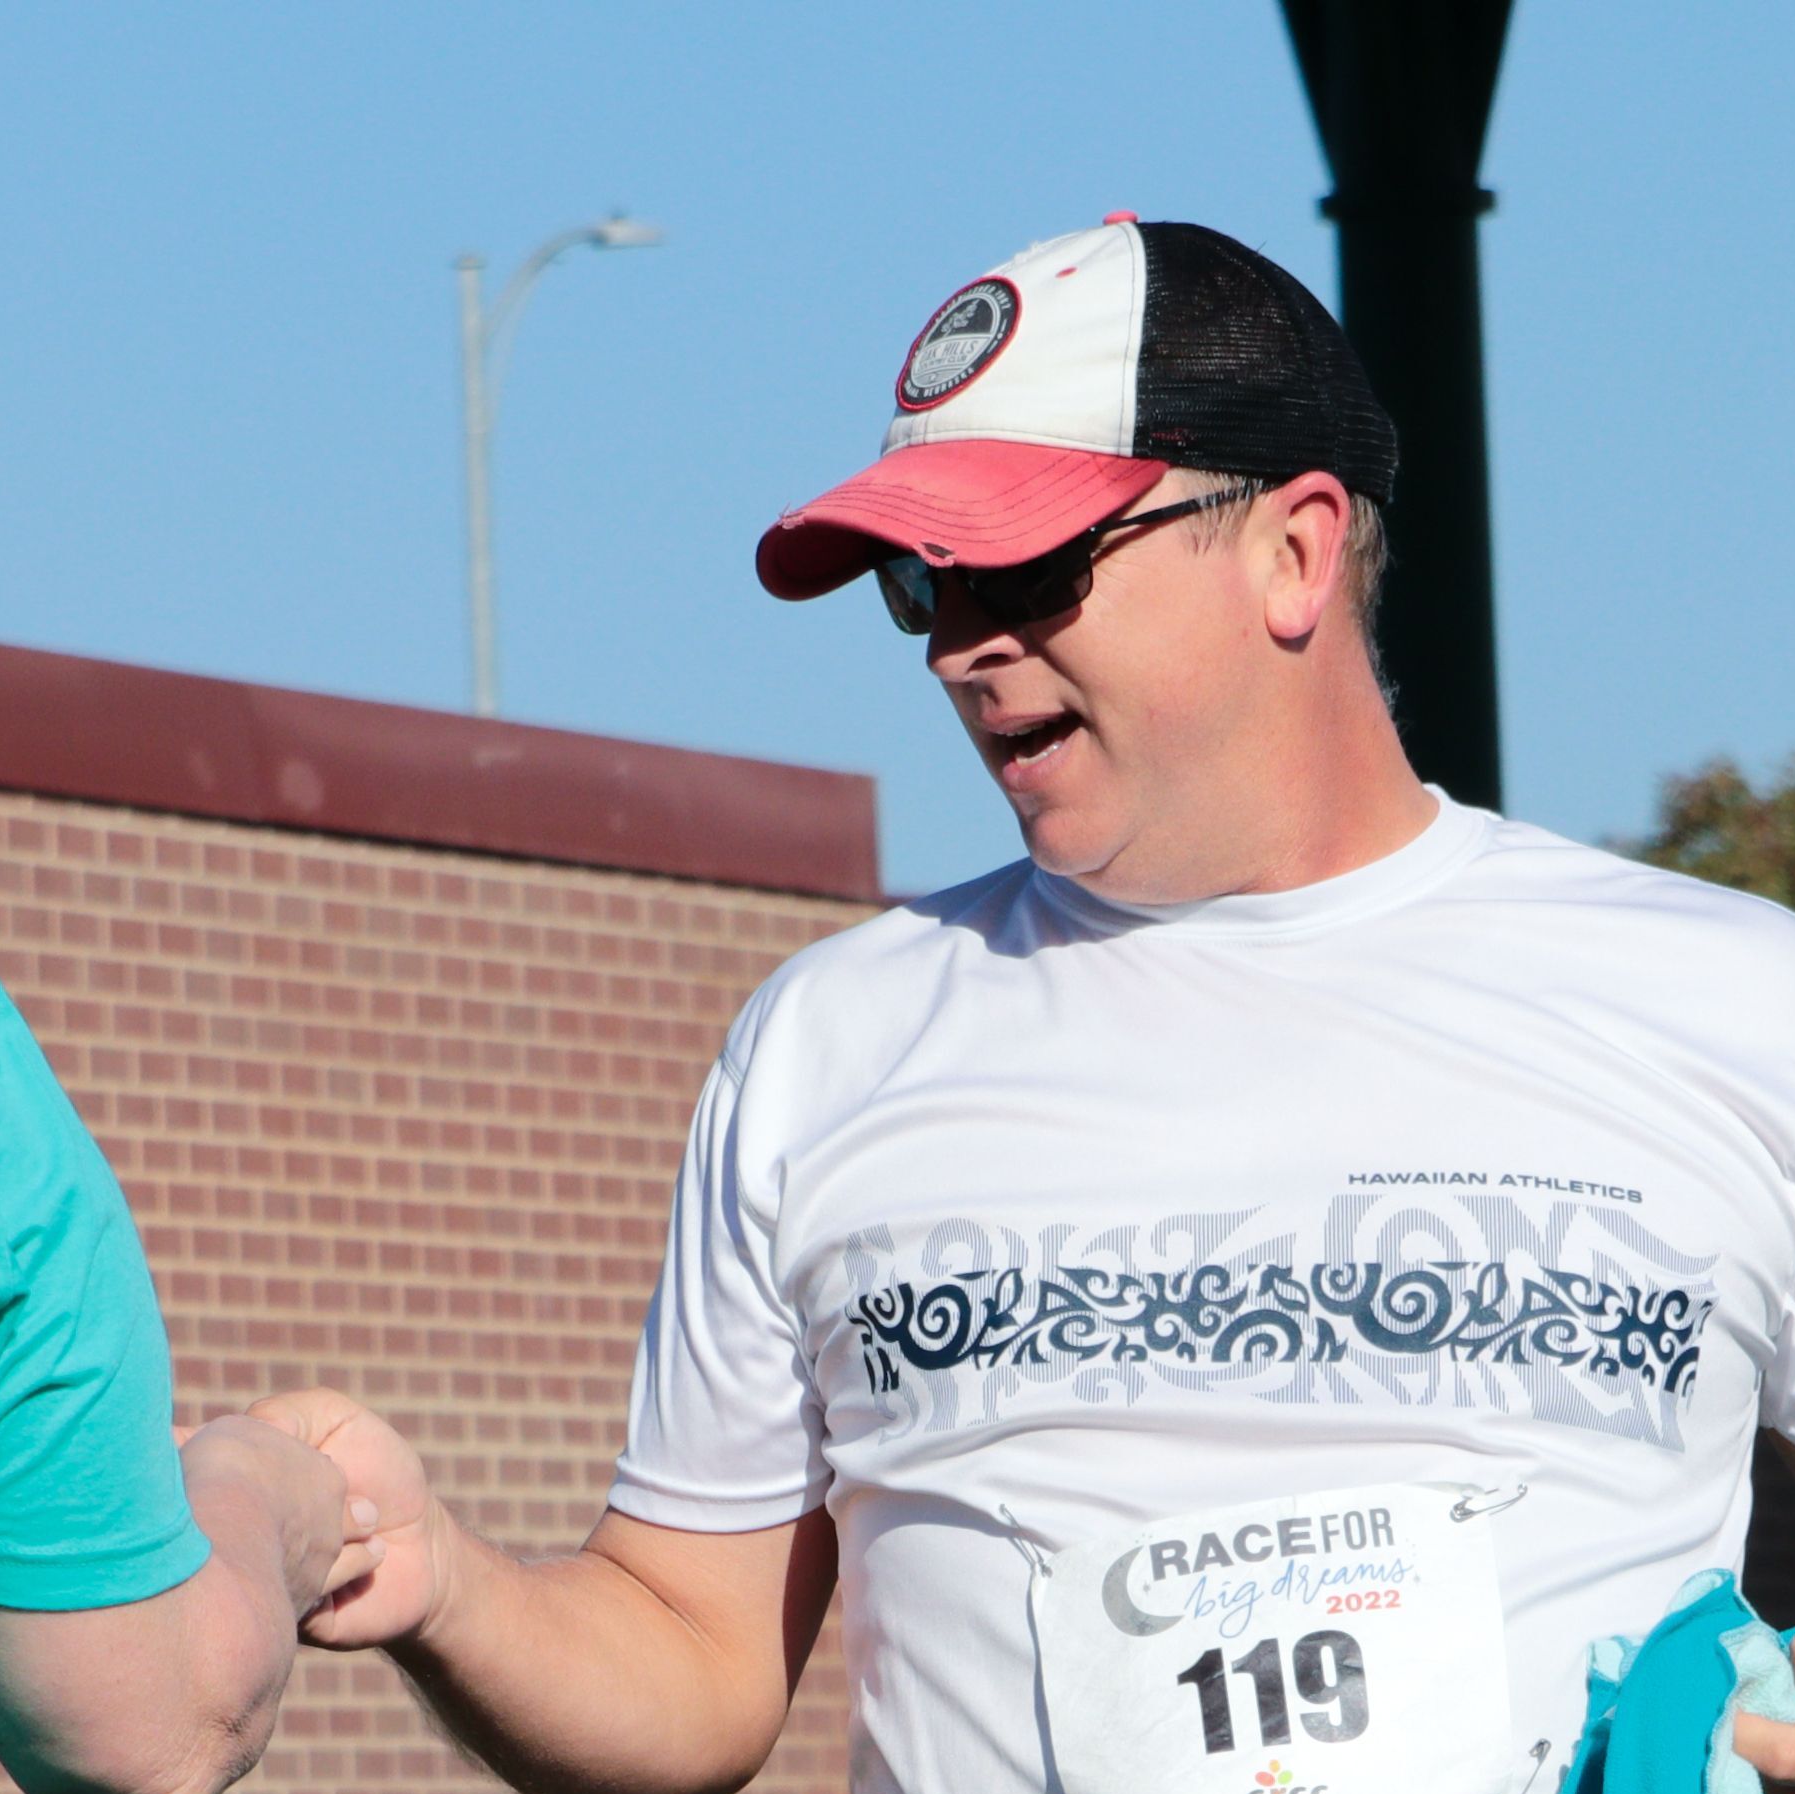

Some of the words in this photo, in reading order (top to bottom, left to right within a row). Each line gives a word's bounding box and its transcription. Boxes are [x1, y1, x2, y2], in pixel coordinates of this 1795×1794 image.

[1348, 1172, 1488, 1185] HAWAIIAN
[1498, 1173, 1644, 1204] ATHLETICS
[1149, 1517, 1317, 1581] RACE
[1321, 1507, 1396, 1554] FOR
[1184, 1574, 1265, 1640] big
[1271, 1558, 1415, 1605] dreams
[1325, 1589, 1402, 1615] 2022
[1176, 1629, 1370, 1755] 119
